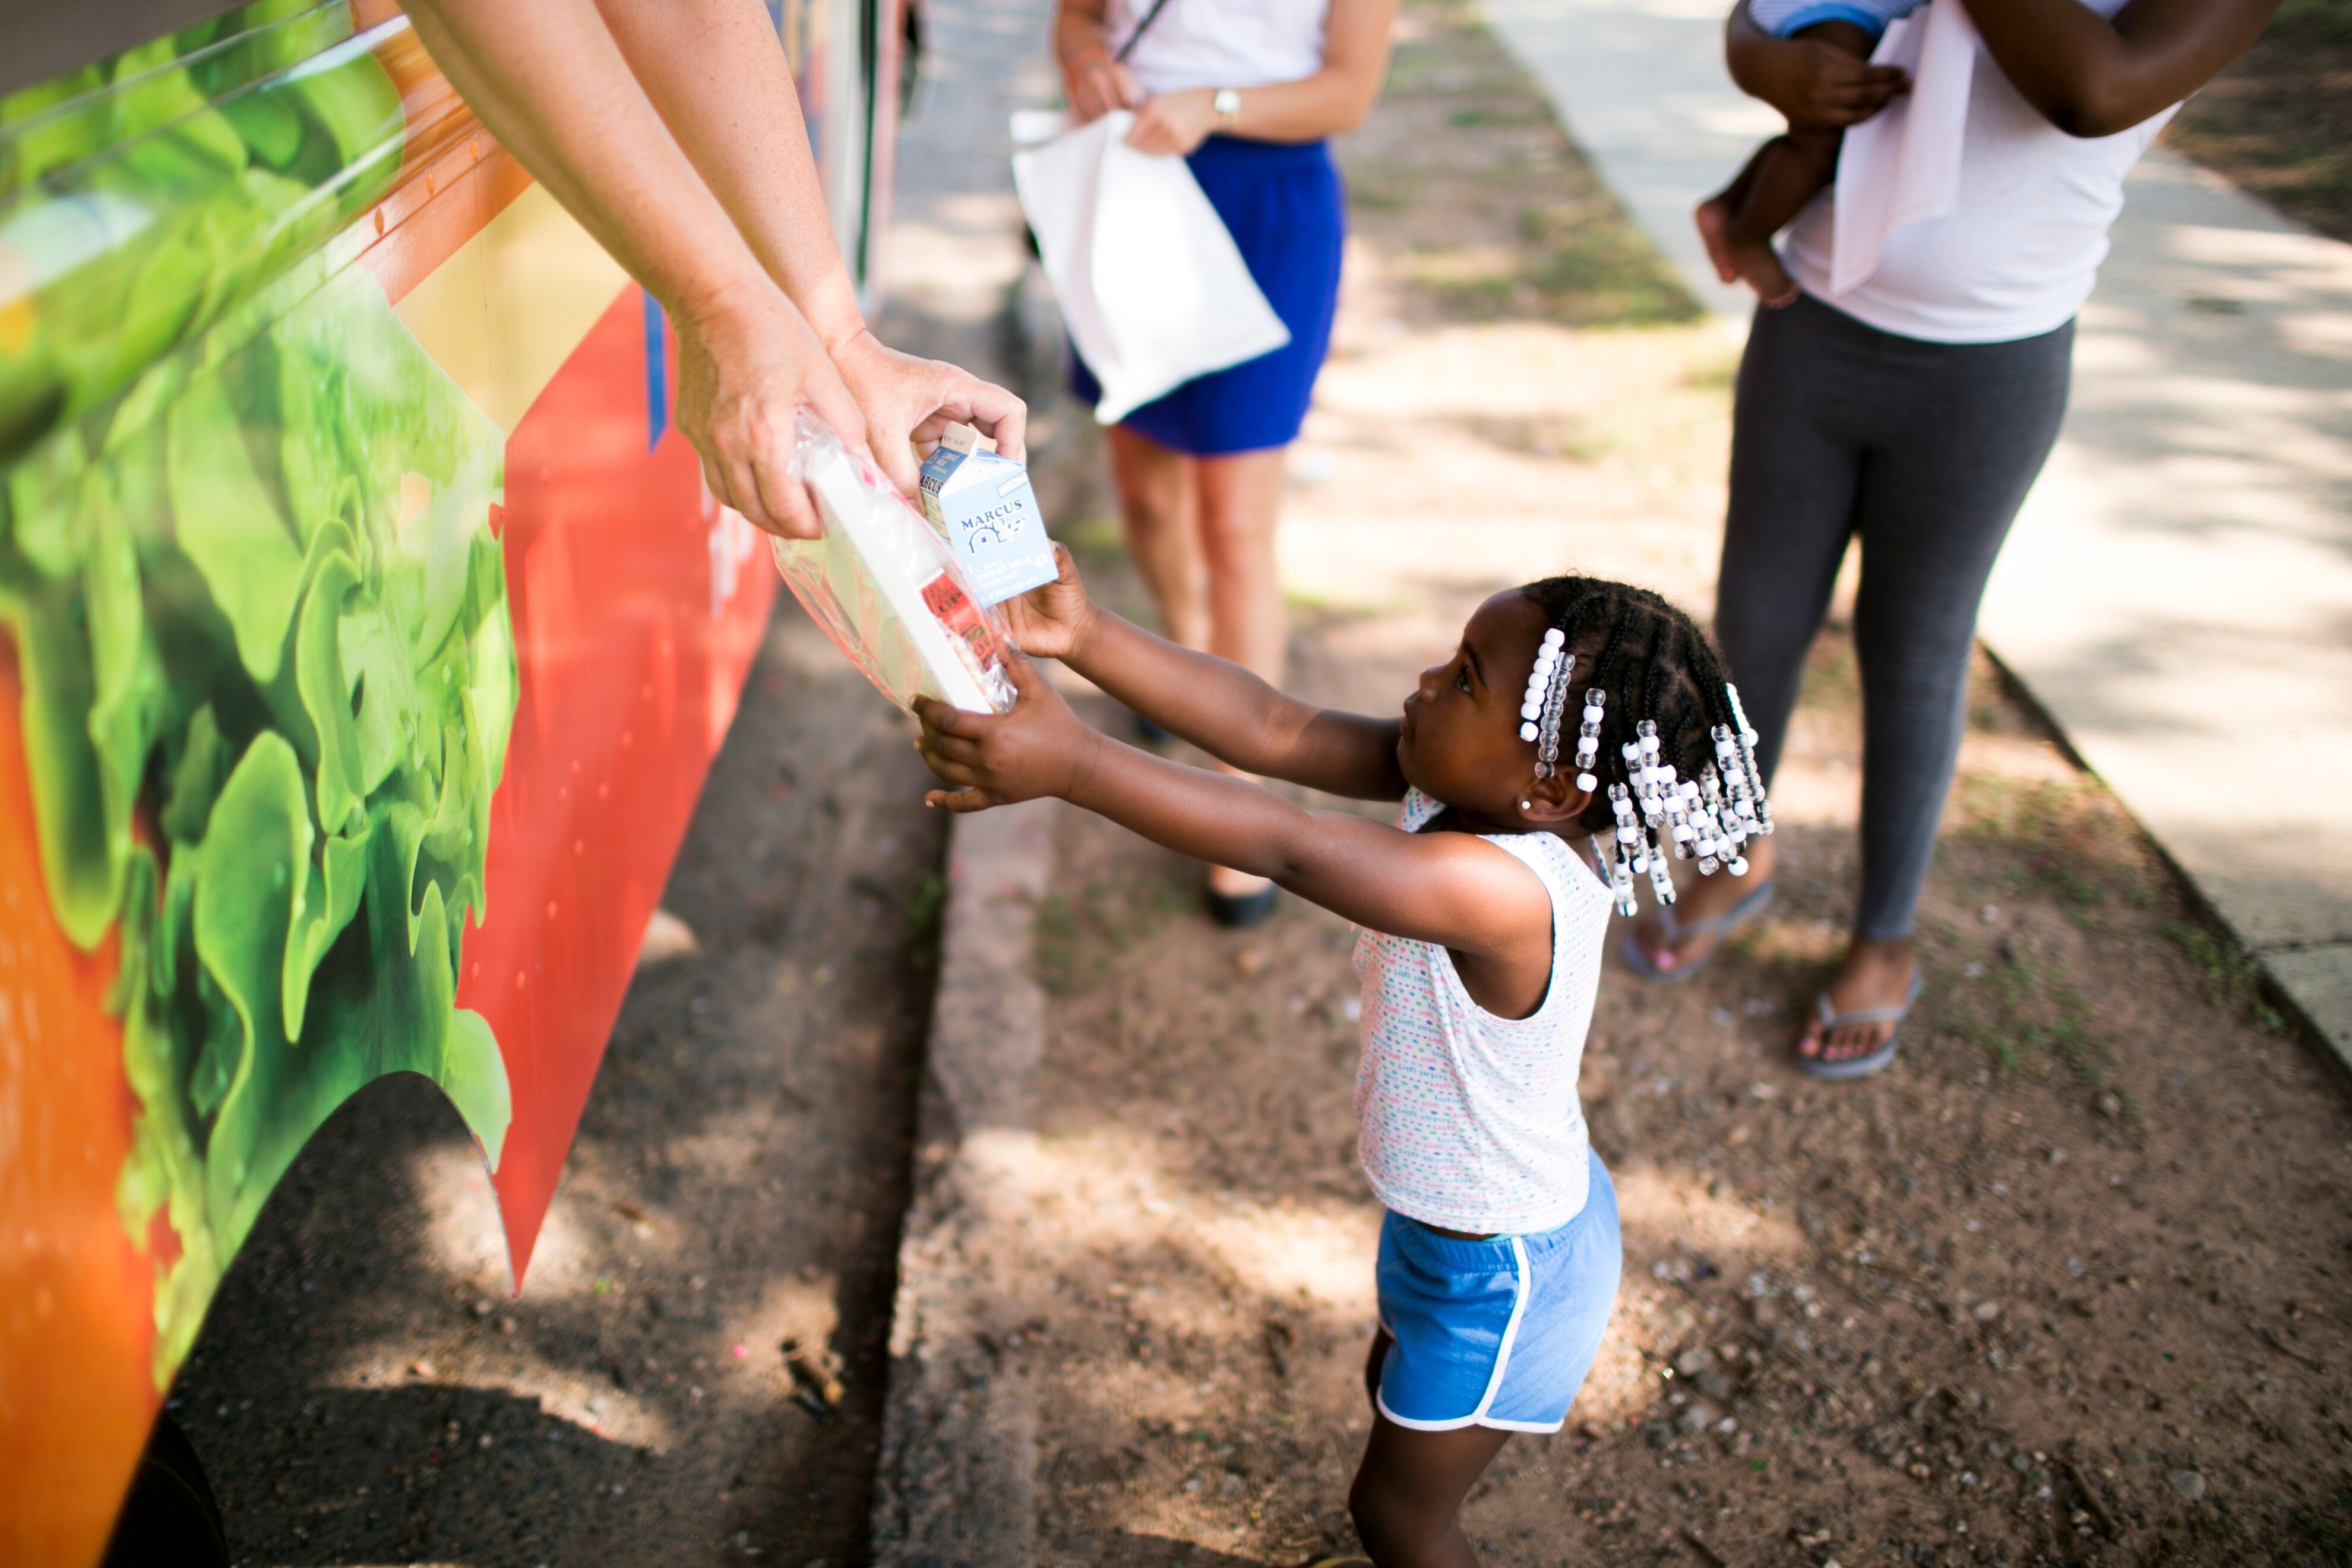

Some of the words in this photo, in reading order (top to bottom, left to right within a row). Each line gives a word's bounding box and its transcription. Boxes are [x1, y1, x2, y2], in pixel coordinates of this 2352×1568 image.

[920, 473, 943, 494] ARCUS
[960, 499, 1022, 531] MARCUS
[976, 564, 1008, 583] OWFAT
[1394, 969, 1411, 979] girl
[1398, 1018, 1414, 1027] girl
[1418, 1025, 1442, 1038] total
[1398, 1064, 1416, 1073] girl
[1420, 1070, 1447, 1082] total
[1421, 1114, 1451, 1125] total
